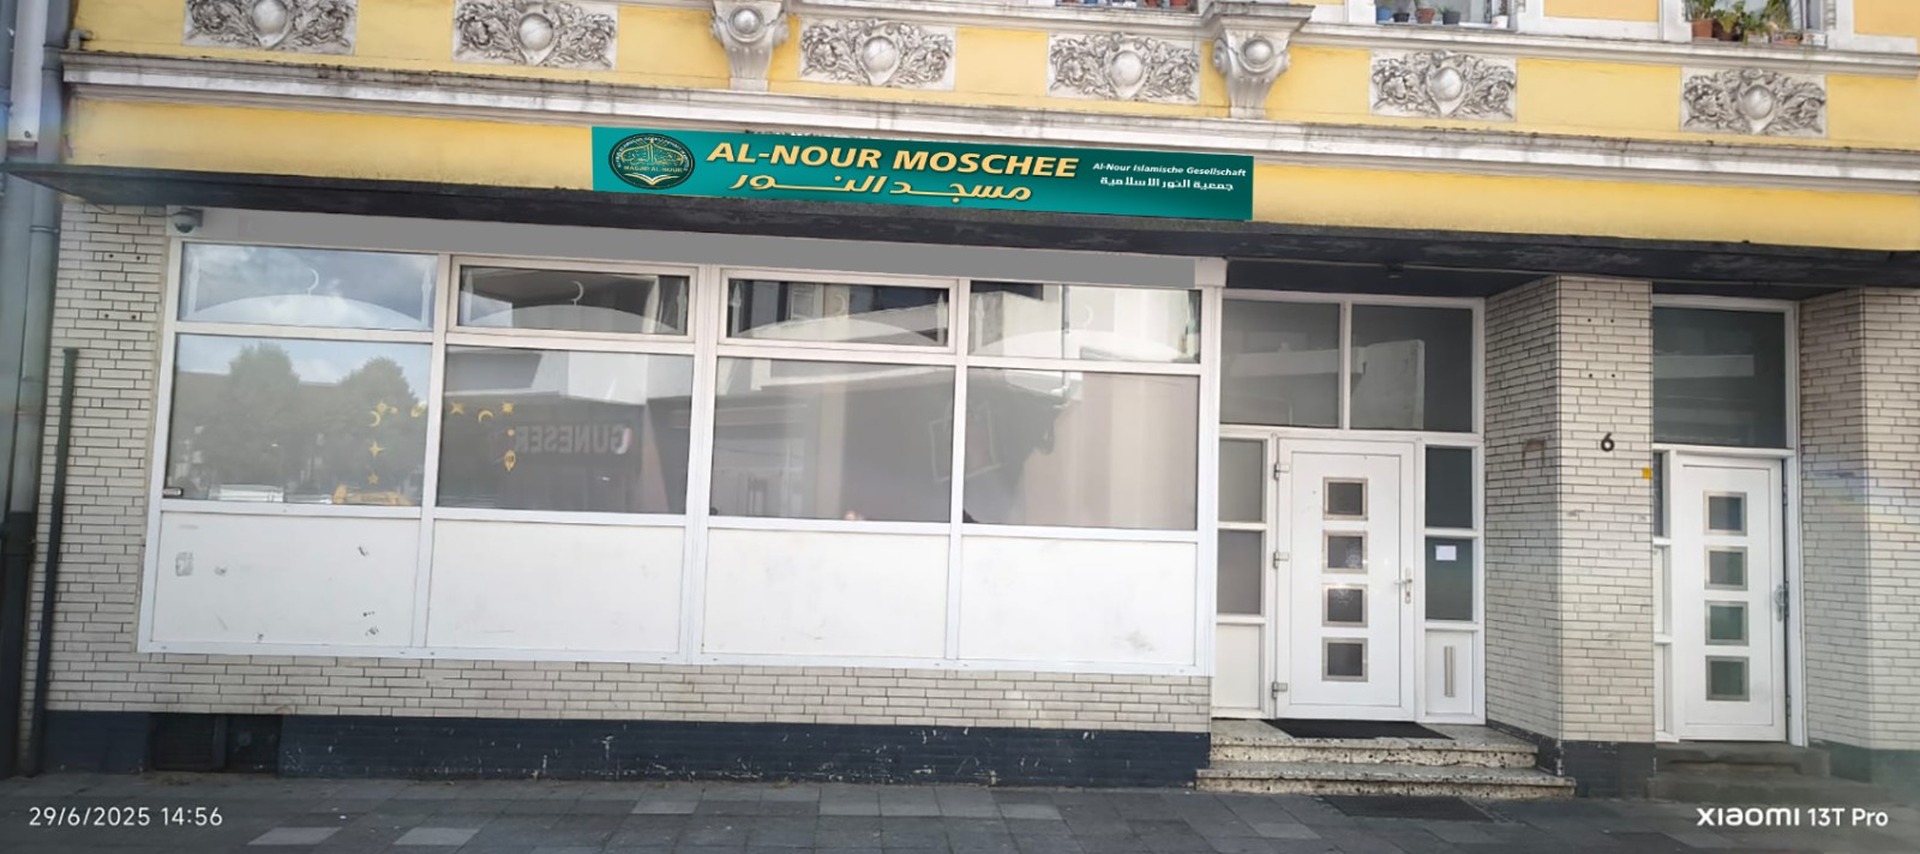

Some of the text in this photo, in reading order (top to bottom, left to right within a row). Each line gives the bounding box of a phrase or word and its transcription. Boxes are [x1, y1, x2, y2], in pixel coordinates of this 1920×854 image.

[706, 142, 882, 169] AL-NOUR
[892, 150, 1079, 177] MOSCHEE
[1092, 162, 1247, 177] Al-Nour Islamische Gesellschaft
[730, 174, 1032, 203] مسجد النور
[1162, 179, 1191, 189] النور
[1193, 180, 1234, 191] جمعية
[1601, 432, 1614, 452] 6
